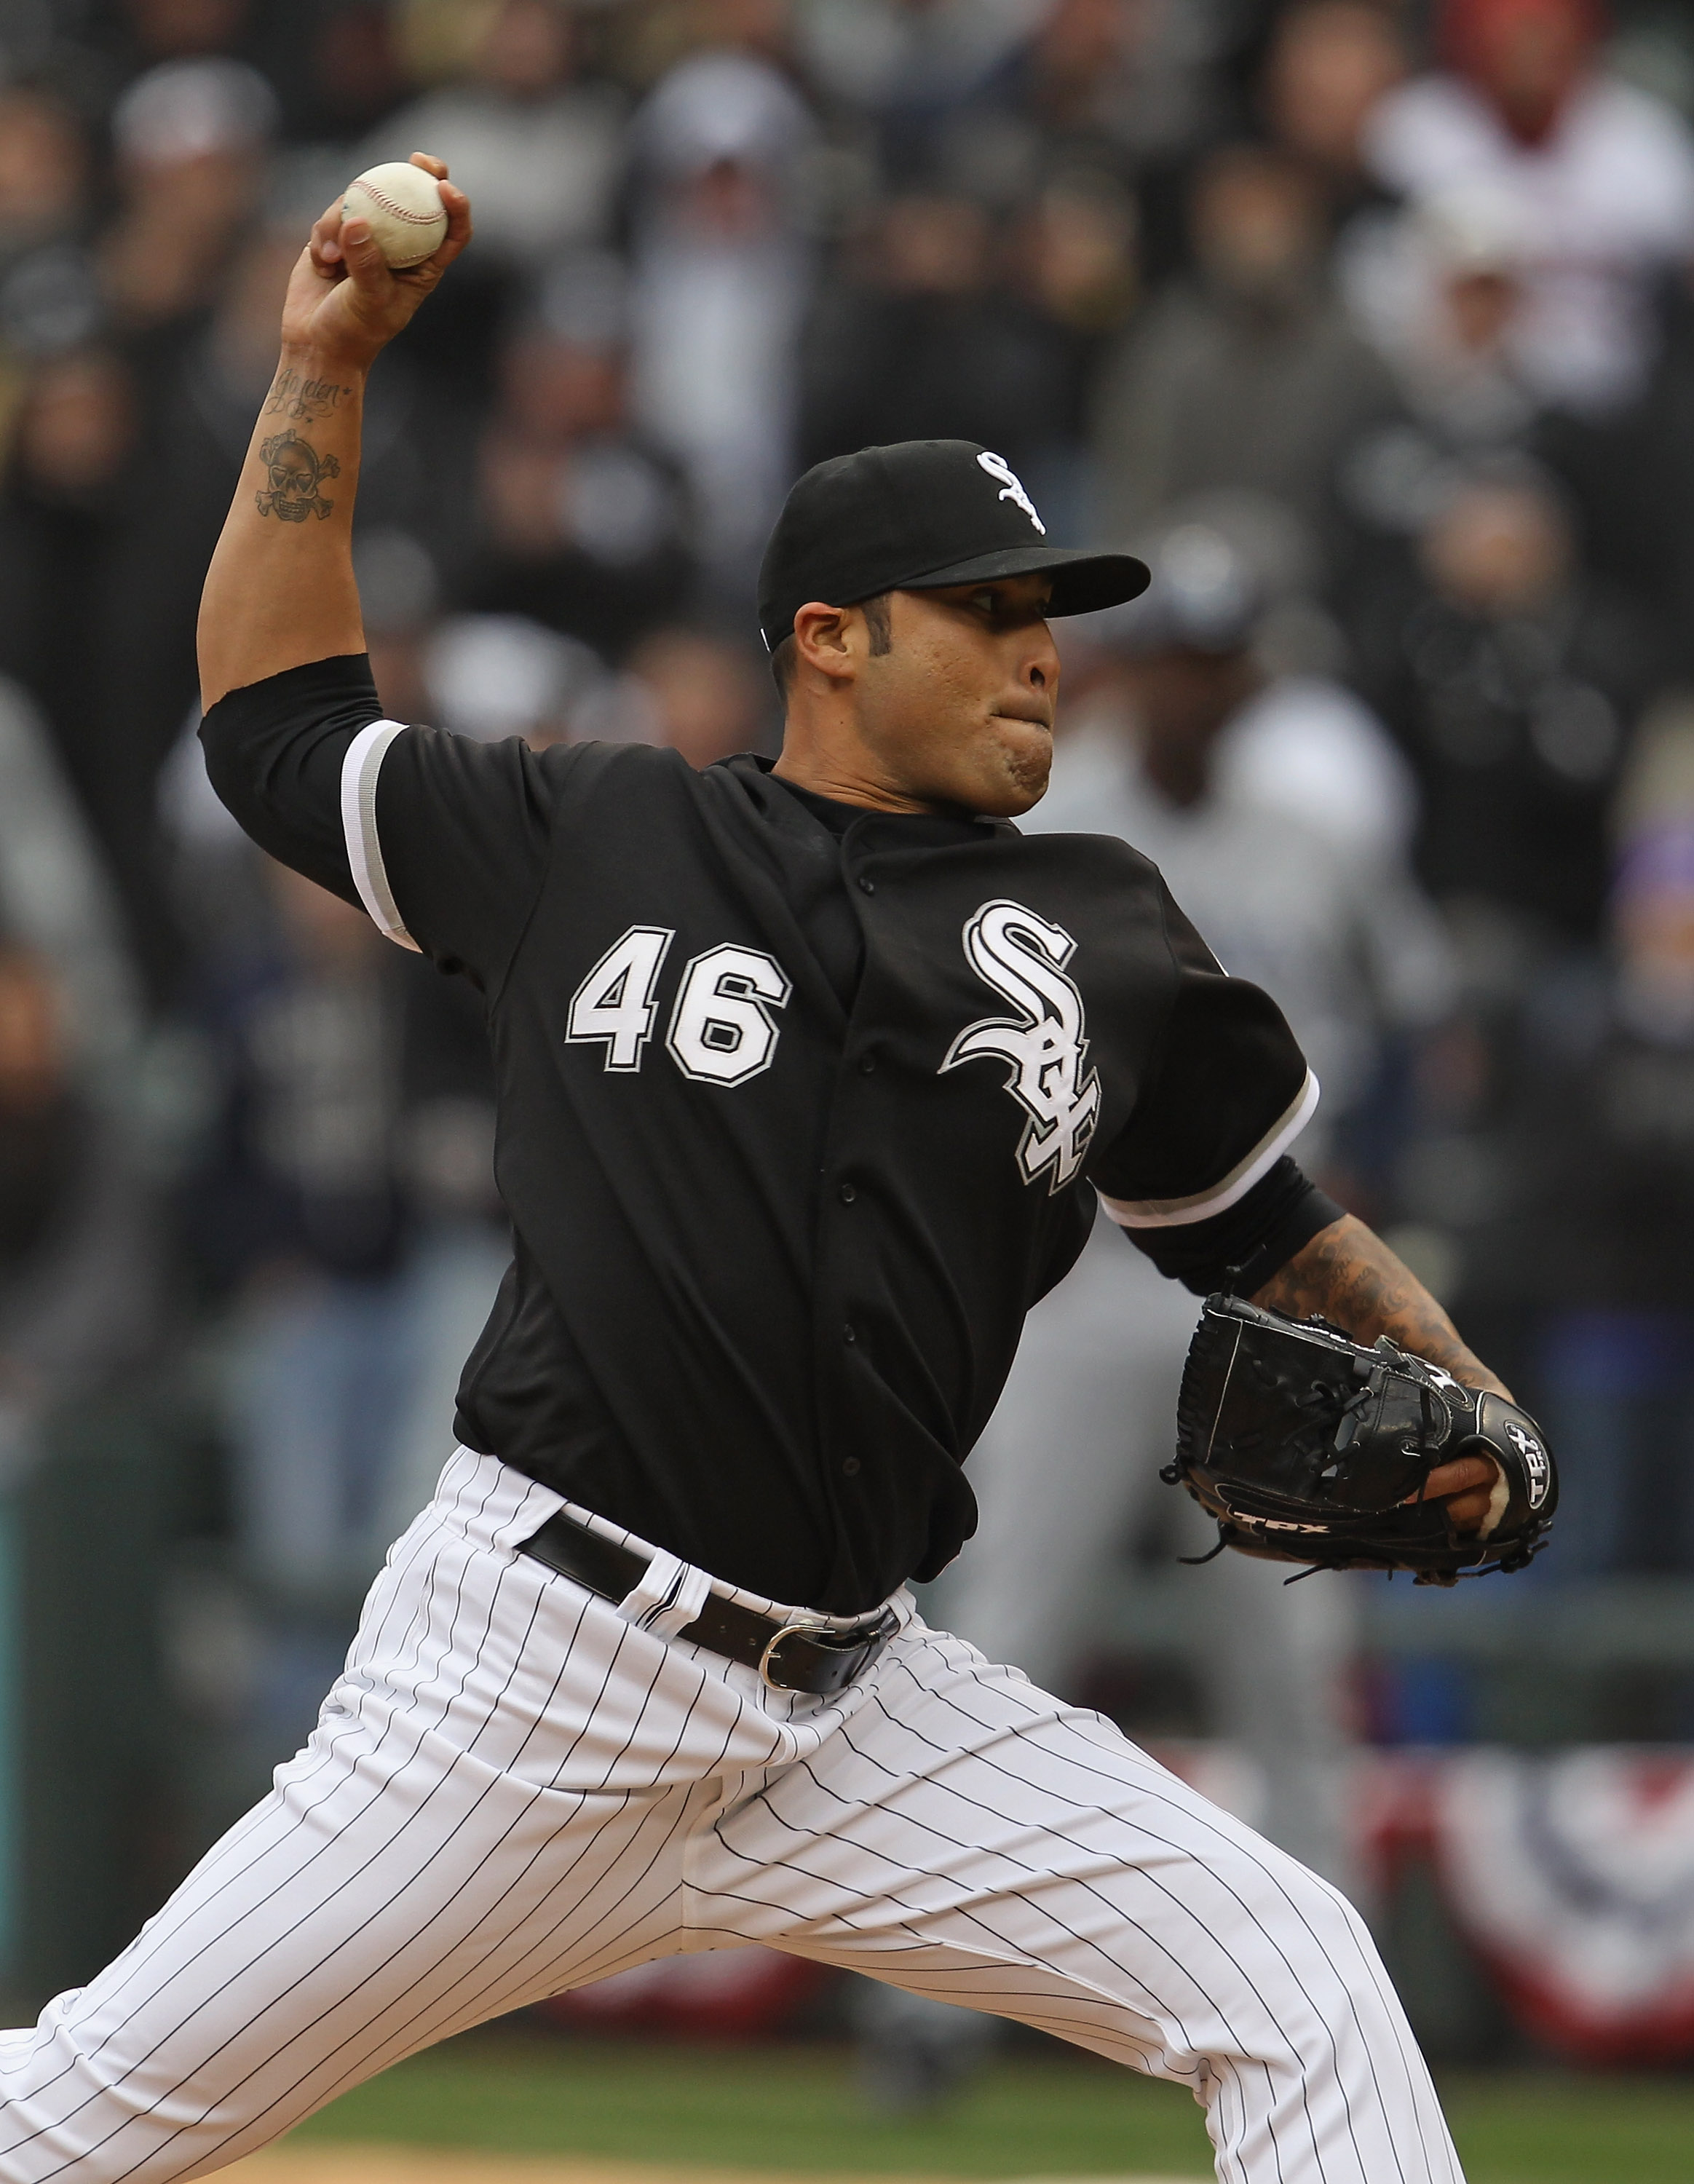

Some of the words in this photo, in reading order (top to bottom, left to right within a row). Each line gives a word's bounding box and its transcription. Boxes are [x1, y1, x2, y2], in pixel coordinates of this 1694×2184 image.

[564, 925, 793, 1088] 46
[937, 898, 1102, 1196] Sox
[1233, 1511, 1331, 1534] TPX
[1508, 1427, 1544, 1503] TPX
